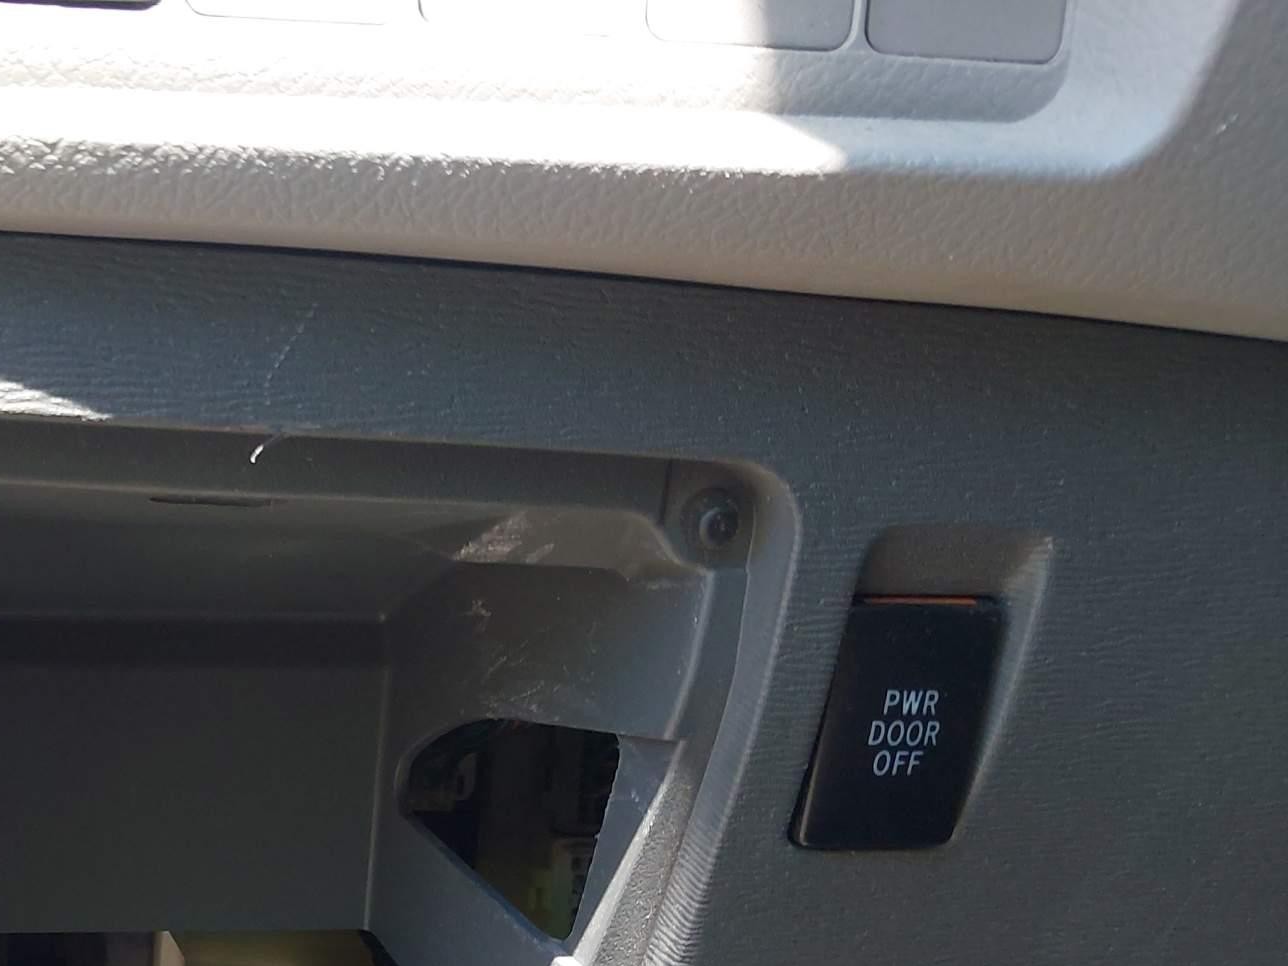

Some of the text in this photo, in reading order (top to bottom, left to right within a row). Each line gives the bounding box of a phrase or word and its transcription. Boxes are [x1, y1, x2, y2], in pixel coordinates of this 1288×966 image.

[883, 689, 940, 716] PWR
[868, 720, 940, 747] DOOR
[873, 749, 924, 776] OFF
